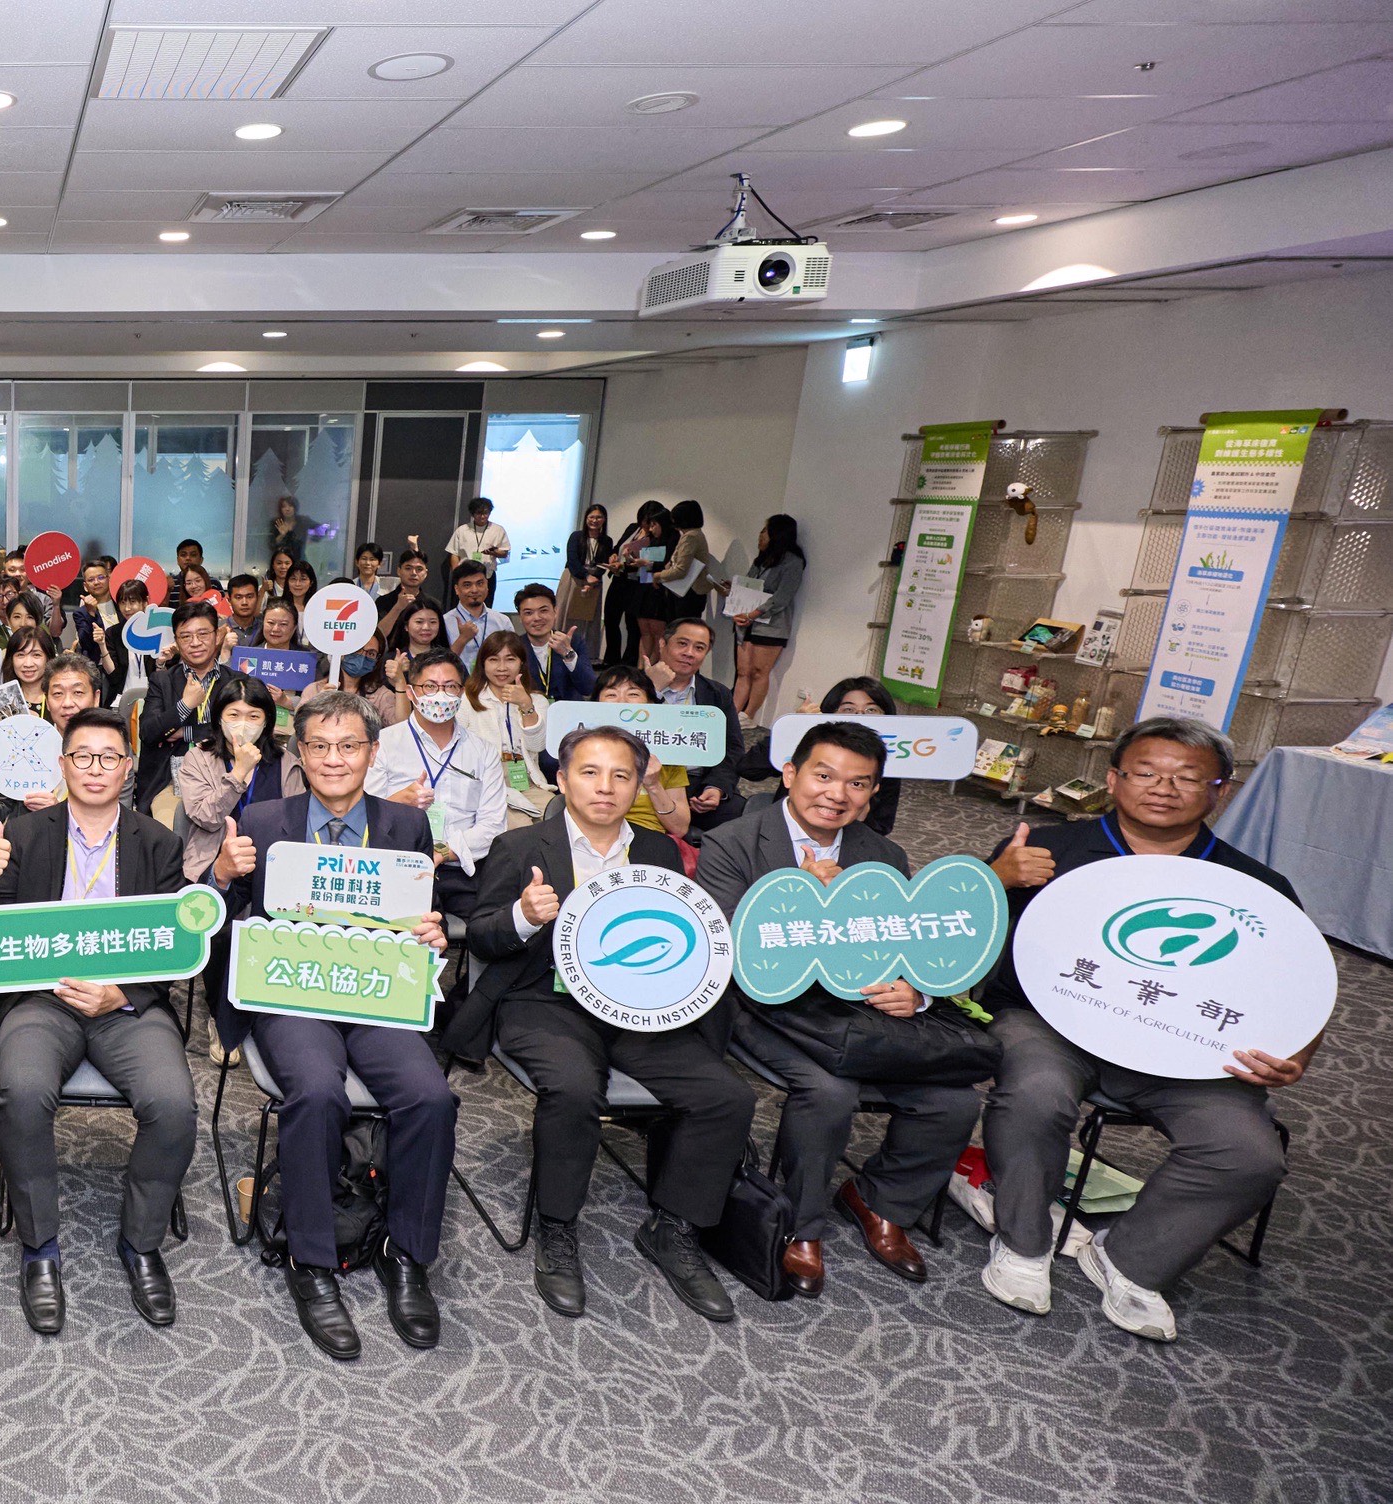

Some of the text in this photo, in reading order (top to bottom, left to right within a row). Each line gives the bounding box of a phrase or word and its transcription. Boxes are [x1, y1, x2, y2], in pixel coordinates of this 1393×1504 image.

[33, 552, 73, 574] innodisk
[262, 660, 309, 674] 凱基人壽
[636, 729, 707, 751] 賦能永續
[5, 779, 47, 790] Xpark
[310, 891, 381, 907] 股份有限公司
[311, 875, 382, 895] 致伸科技
[587, 869, 729, 956] 農業部水產試驗所
[758, 910, 976, 949] 農業永續進行式
[265, 956, 392, 999] 公私協力
[560, 912, 721, 1026] FISHERIES RESEARCH INSTITUTE
[1059, 958, 1244, 1032] 農業部
[1052, 985, 1228, 1052] MINISTRY OF AGRICULTURE
